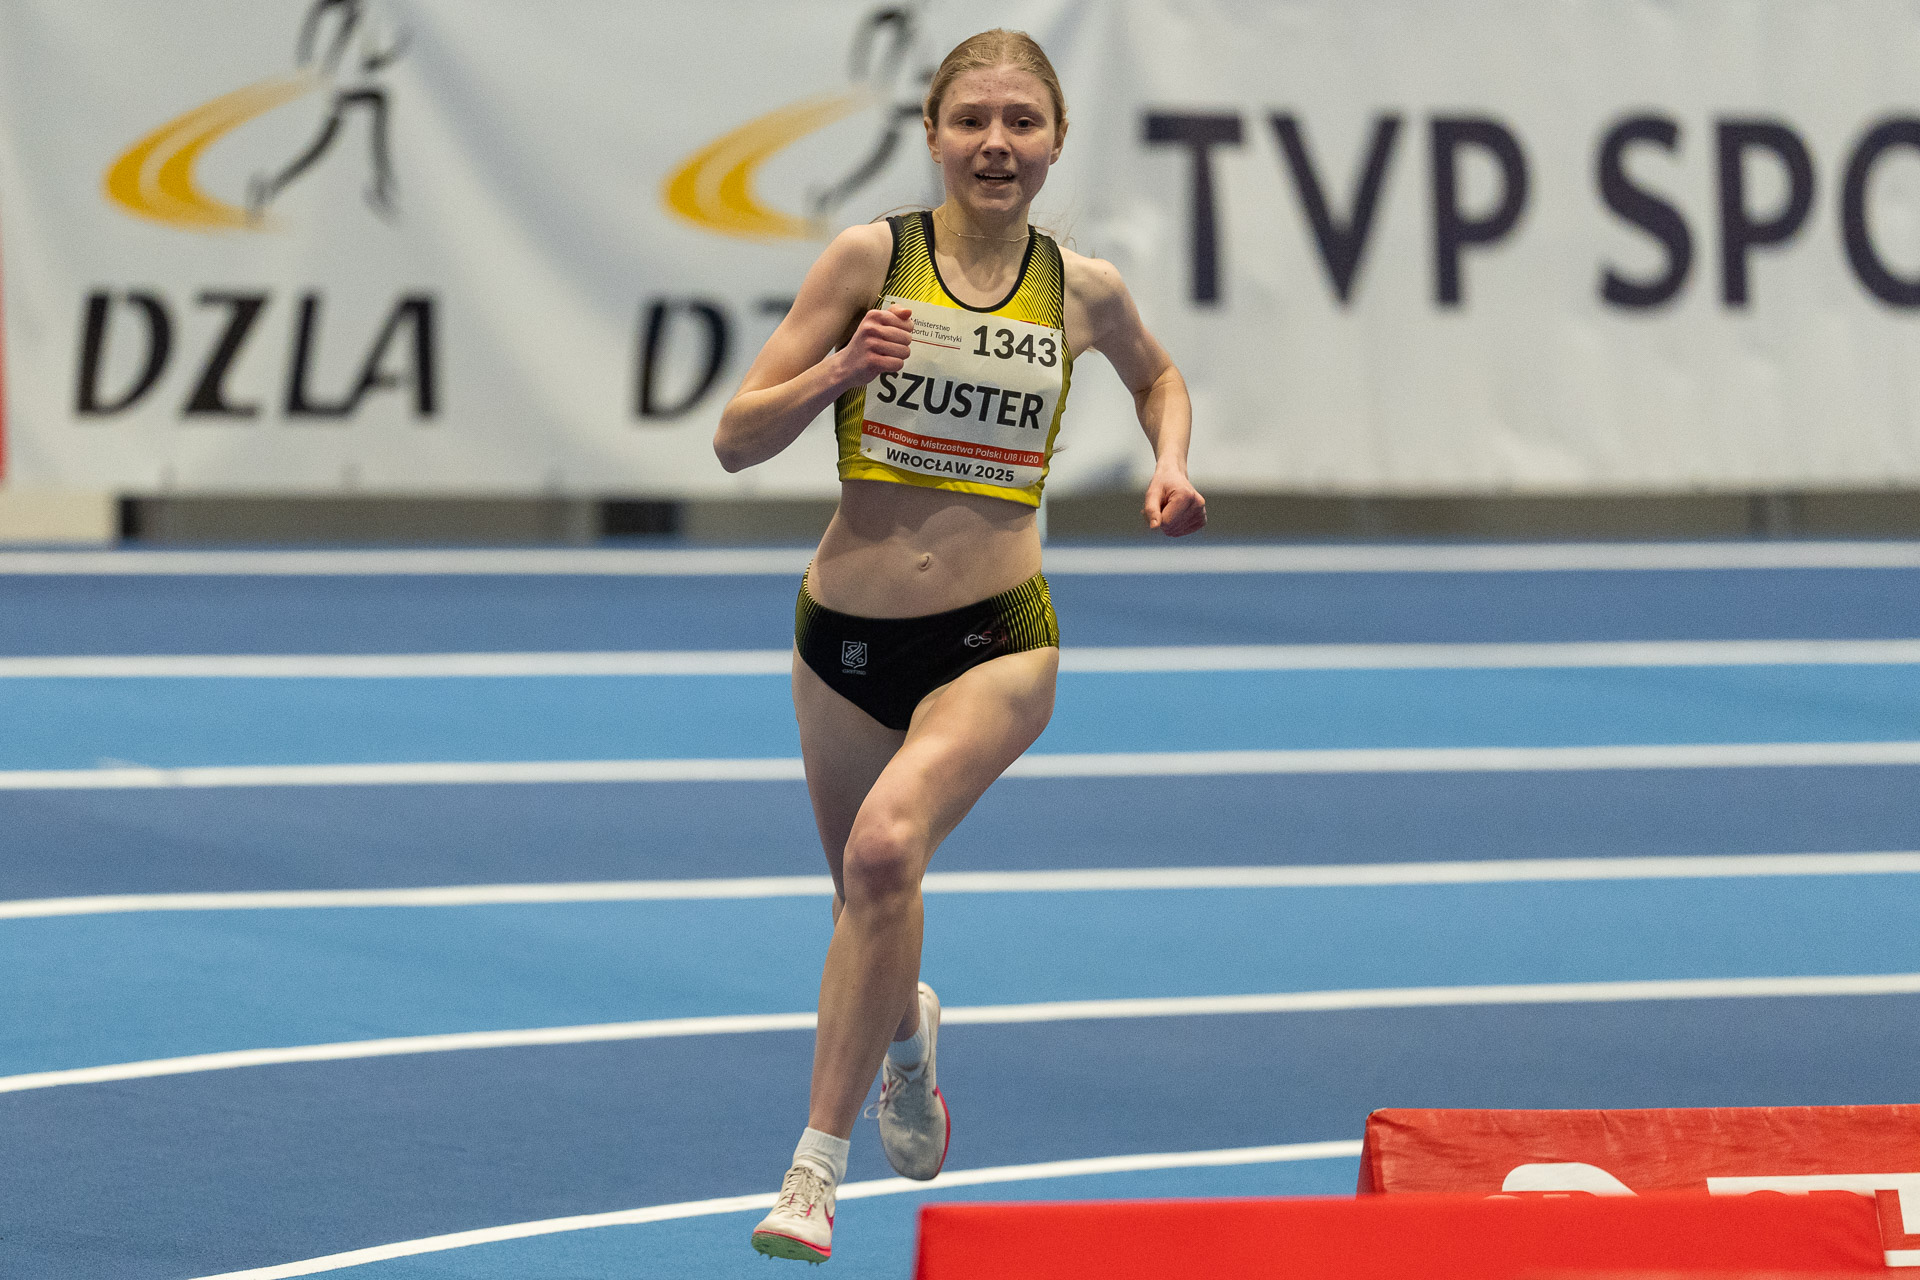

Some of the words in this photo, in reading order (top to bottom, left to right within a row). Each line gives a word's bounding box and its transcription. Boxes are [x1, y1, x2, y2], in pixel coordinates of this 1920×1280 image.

[1143, 112, 1531, 308] TVP
[75, 290, 437, 418] DZLA
[909, 328, 930, 337] portu
[934, 331, 963, 343] Turystyki
[973, 324, 1058, 368] 1343
[876, 370, 1044, 430] SZUSTER
[867, 424, 887, 437] PZLA
[888, 429, 919, 446] Halowe
[920, 439, 974, 456] Mistrzostwa
[975, 447, 1003, 460] Polski
[1003, 452, 1018, 462] U18
[1023, 455, 1039, 464] U20
[886, 446, 973, 476] WROCŁAW
[974, 464, 1015, 482] 2025
